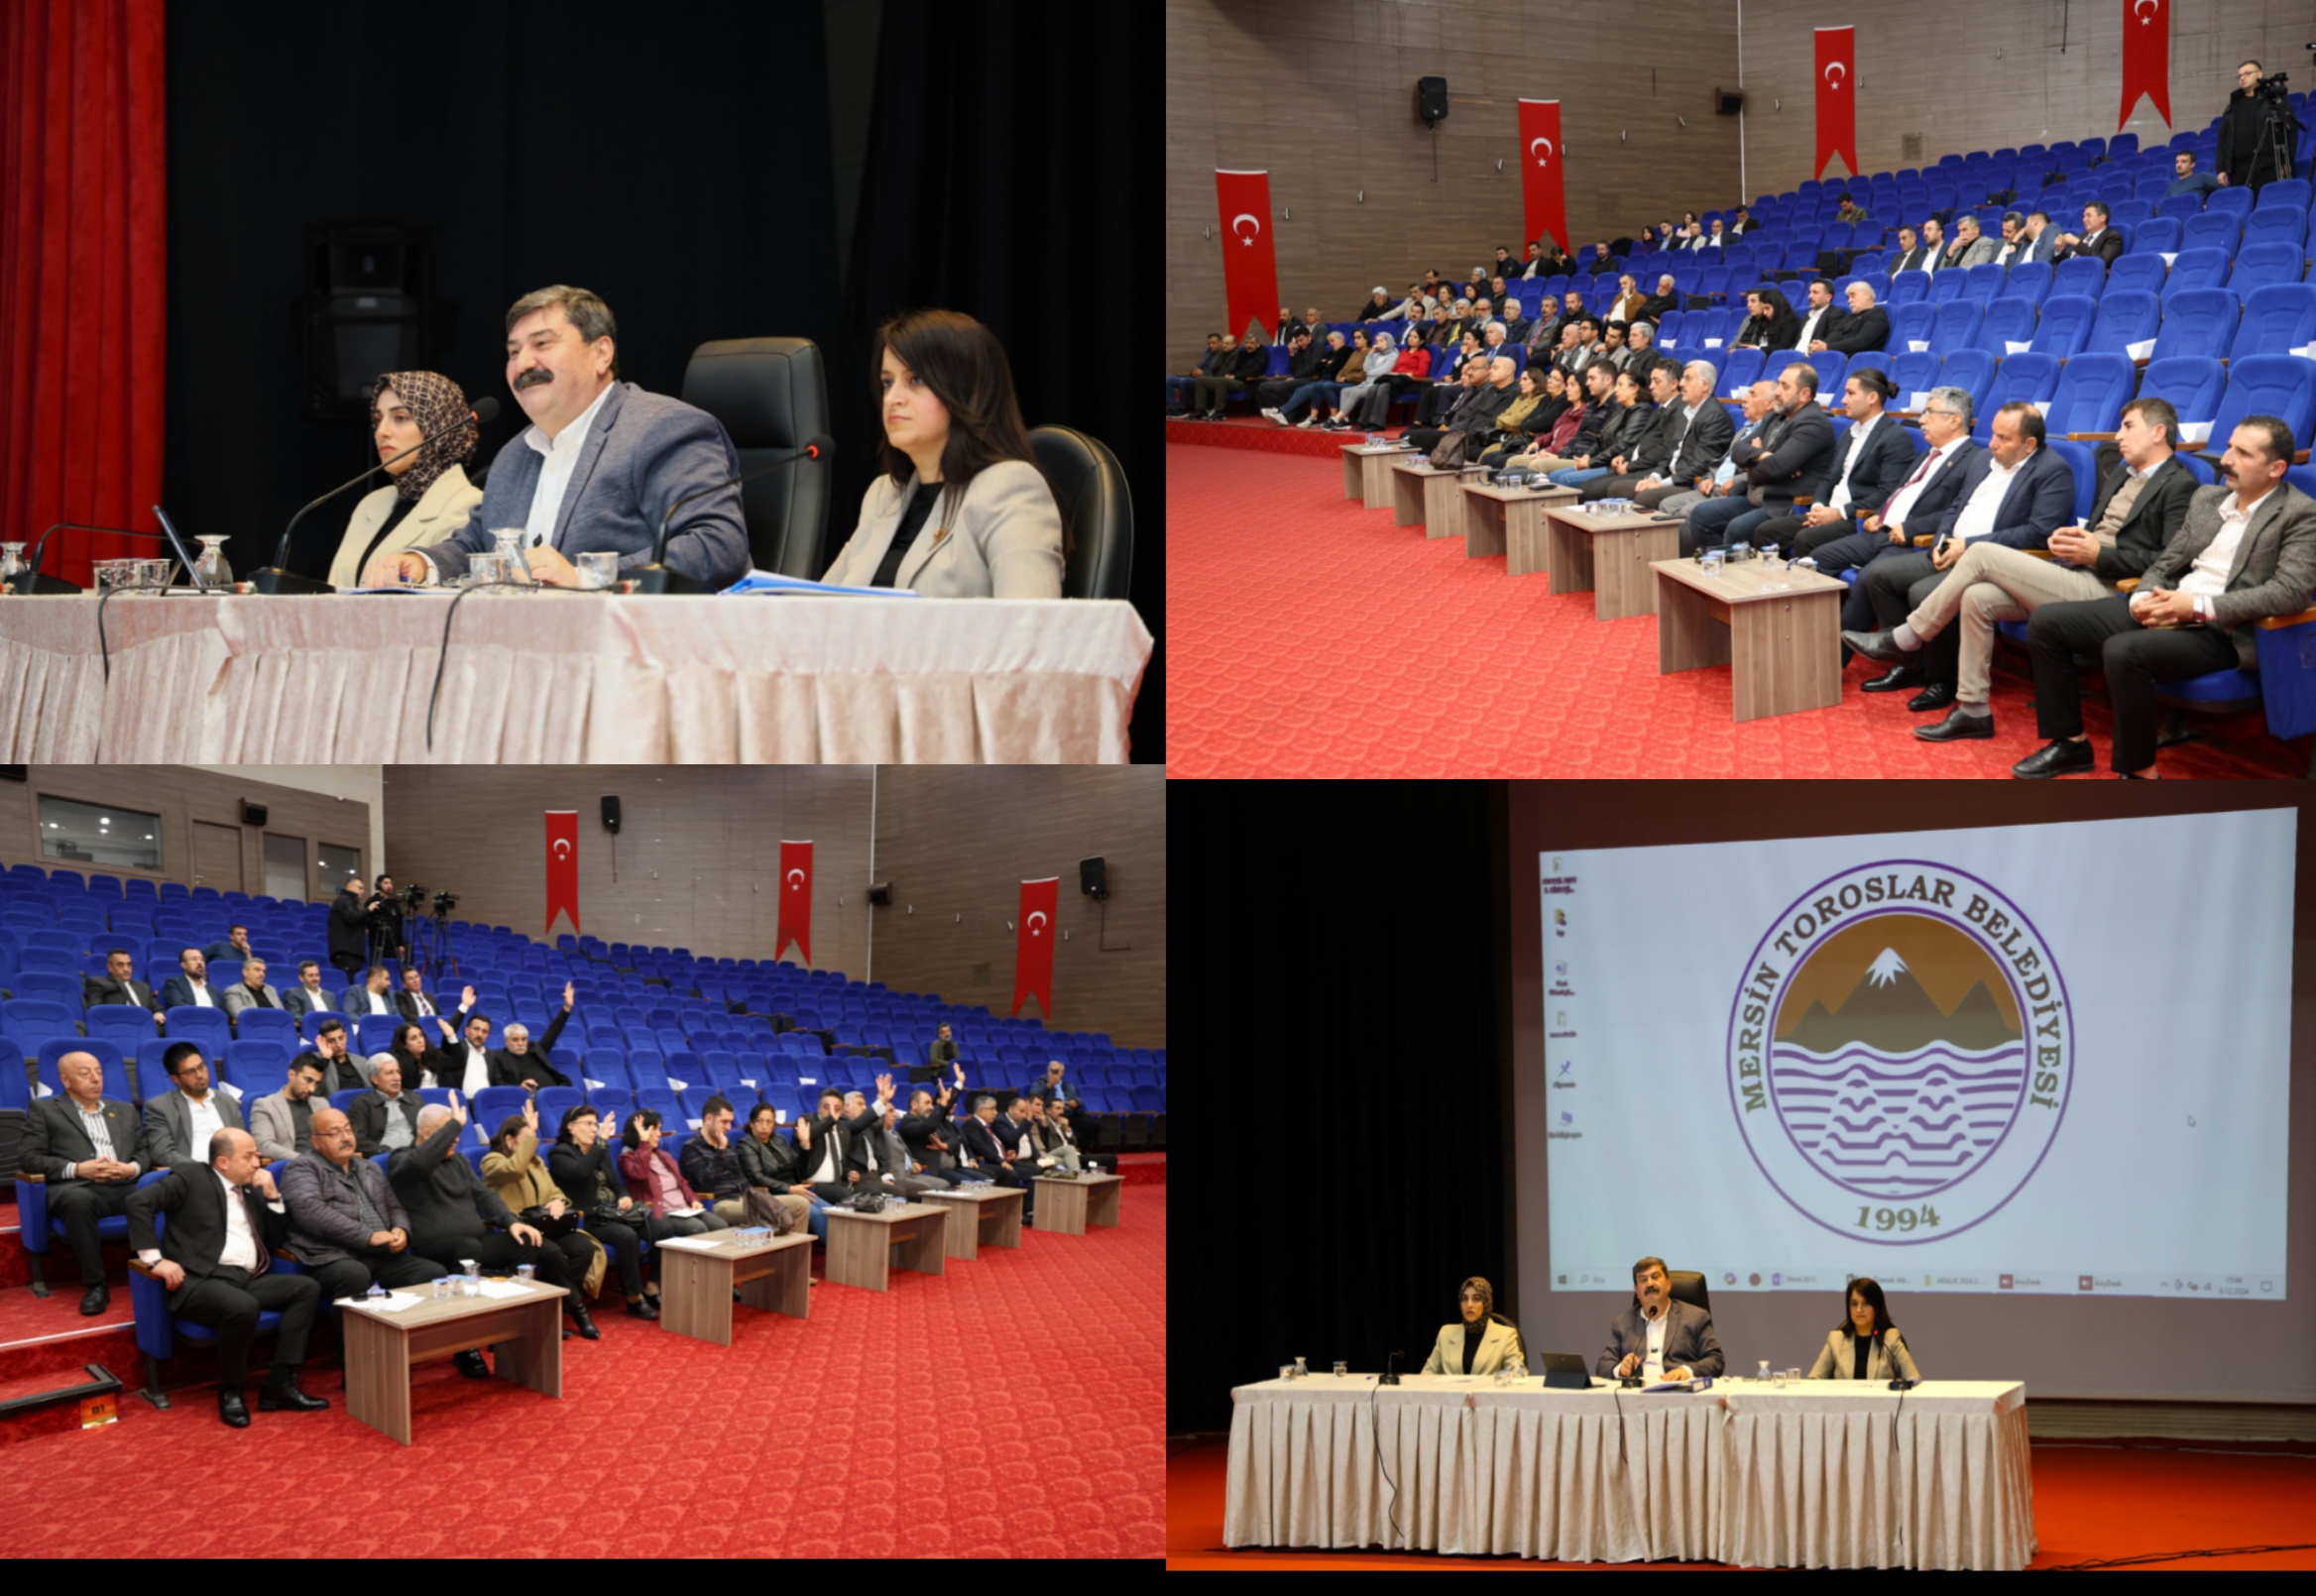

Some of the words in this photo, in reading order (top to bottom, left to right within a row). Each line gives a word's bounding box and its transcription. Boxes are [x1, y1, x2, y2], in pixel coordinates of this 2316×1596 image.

[1739, 962, 1781, 1114] MERSİN
[1774, 874, 1957, 960] TOROSLAR
[1962, 893, 2064, 1110] BELEDİYESİ
[1853, 1203, 1941, 1232] 1994
[2015, 1278, 2041, 1287] AnyDesk
[2095, 1279, 2122, 1288] AnyDesk
